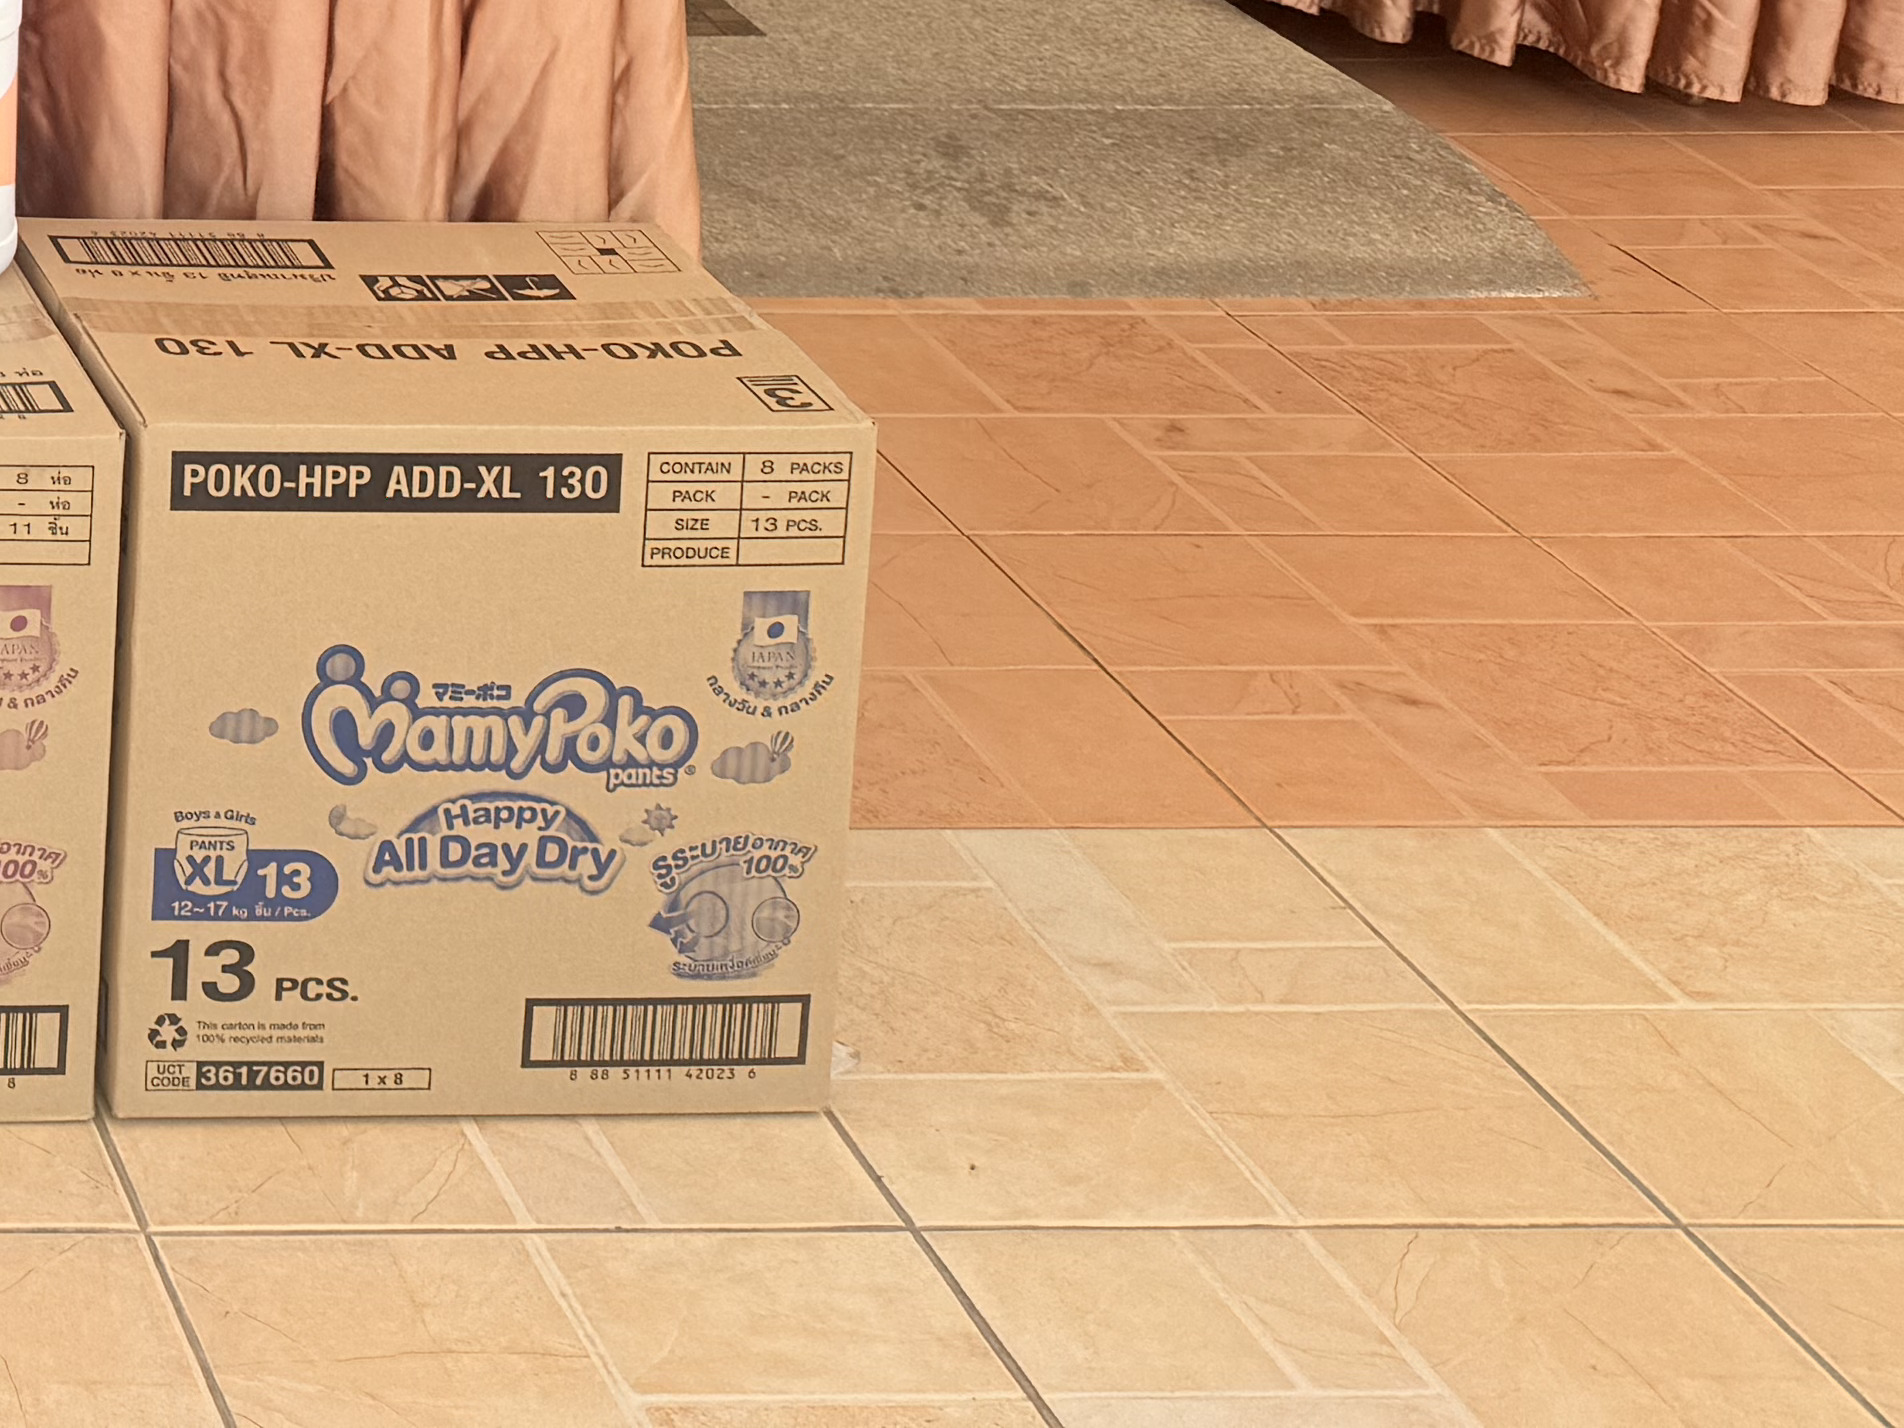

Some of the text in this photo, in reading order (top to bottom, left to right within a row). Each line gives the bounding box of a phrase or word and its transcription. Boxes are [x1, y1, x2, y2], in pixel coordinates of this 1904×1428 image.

[157, 335, 743, 363] POKO-HPP ADD-XL 130
[182, 462, 610, 501] POKO-HPP ADD-XL 130
[307, 669, 695, 783] MamyPoko
[444, 801, 561, 833] Happy
[200, 1063, 321, 1087] 3617660
